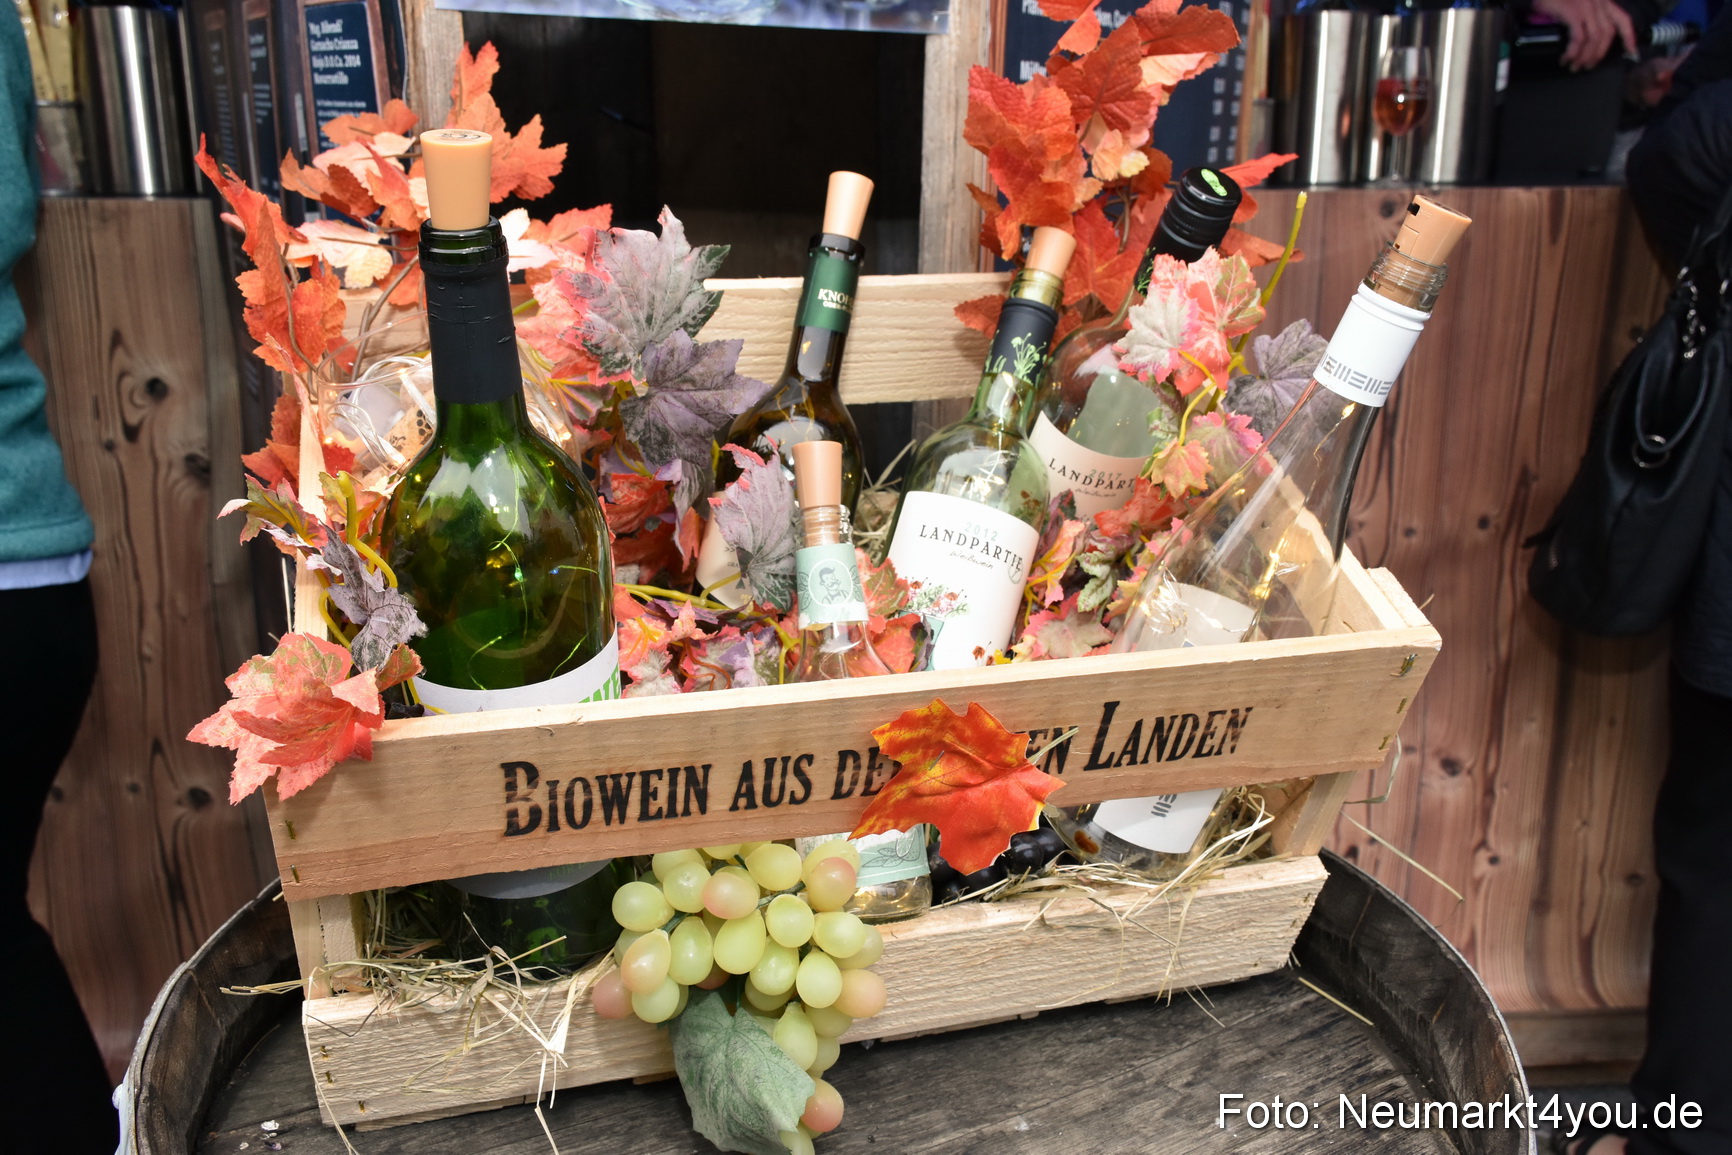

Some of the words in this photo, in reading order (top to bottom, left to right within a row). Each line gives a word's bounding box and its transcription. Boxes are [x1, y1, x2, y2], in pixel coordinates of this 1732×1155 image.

[1049, 458, 1136, 490] LANDPART
[918, 524, 1024, 573] LANDPARTIE
[728, 753, 815, 813] AUS
[1083, 700, 1254, 773] LANDEN
